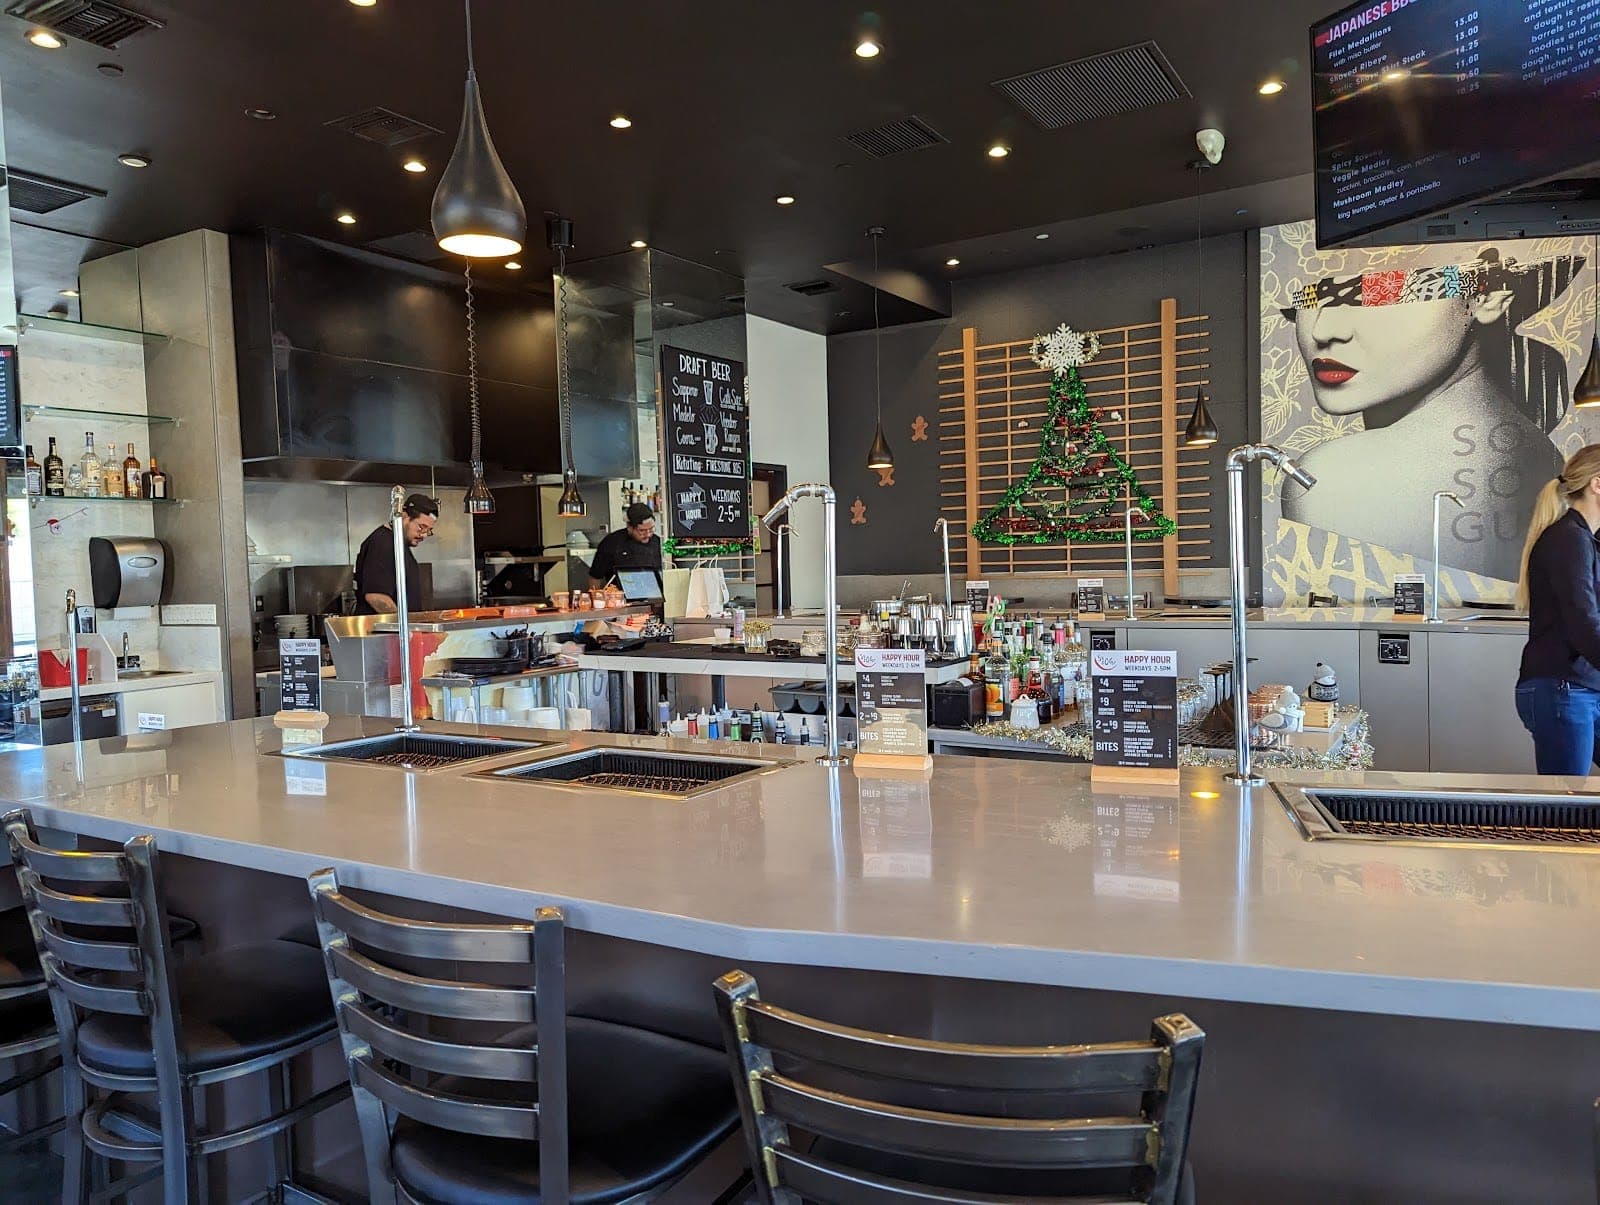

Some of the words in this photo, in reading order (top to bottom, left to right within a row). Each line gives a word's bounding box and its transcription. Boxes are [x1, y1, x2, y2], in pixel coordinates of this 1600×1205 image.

[1326, 1, 1388, 44] JAPANESE
[1391, 0, 1418, 13] BB
[1524, 10, 1541, 23] and
[1534, 13, 1562, 30] dough
[1565, 9, 1574, 17] is
[1531, 25, 1564, 42] barrels
[1567, 20, 1577, 28] to
[1328, 47, 1345, 60] Filet
[1347, 26, 1392, 51] Medallions
[1455, 39, 1479, 56] 14.25
[1529, 36, 1565, 55] noodles
[1568, 26, 1586, 39] and
[1402, 49, 1426, 65] Steak
[1556, 44, 1574, 55] This
[1455, 53, 1479, 70] 11.00
[1540, 56, 1573, 73] kitchen
[1579, 47, 1594, 58] We
[1571, 60, 1590, 73] and
[1329, 67, 1357, 84] Shaved
[1360, 54, 1387, 71] Ribeye
[1332, 160, 1352, 172] Spicy
[1457, 151, 1481, 166] 10.00
[1332, 170, 1359, 184] Veggie
[1361, 157, 1391, 173] Medley
[1333, 189, 1372, 209] Mushroom
[1374, 178, 1405, 194] Medley
[1406, 180, 1441, 198] portobello
[679, 353, 707, 377] DRAFT
[711, 361, 731, 382] BEER
[680, 491, 702, 505] HAPPY
[710, 489, 741, 503] WEEKDAYS
[685, 508, 702, 521] HOUR
[903, 654, 920, 662] HOUR
[1124, 655, 1149, 664] HAPPY
[1150, 655, 1171, 664] HOUR
[1099, 678, 1109, 687] $4
[1100, 697, 1110, 706] $9
[859, 732, 879, 740] BITES
[1095, 741, 1119, 752] BITES
